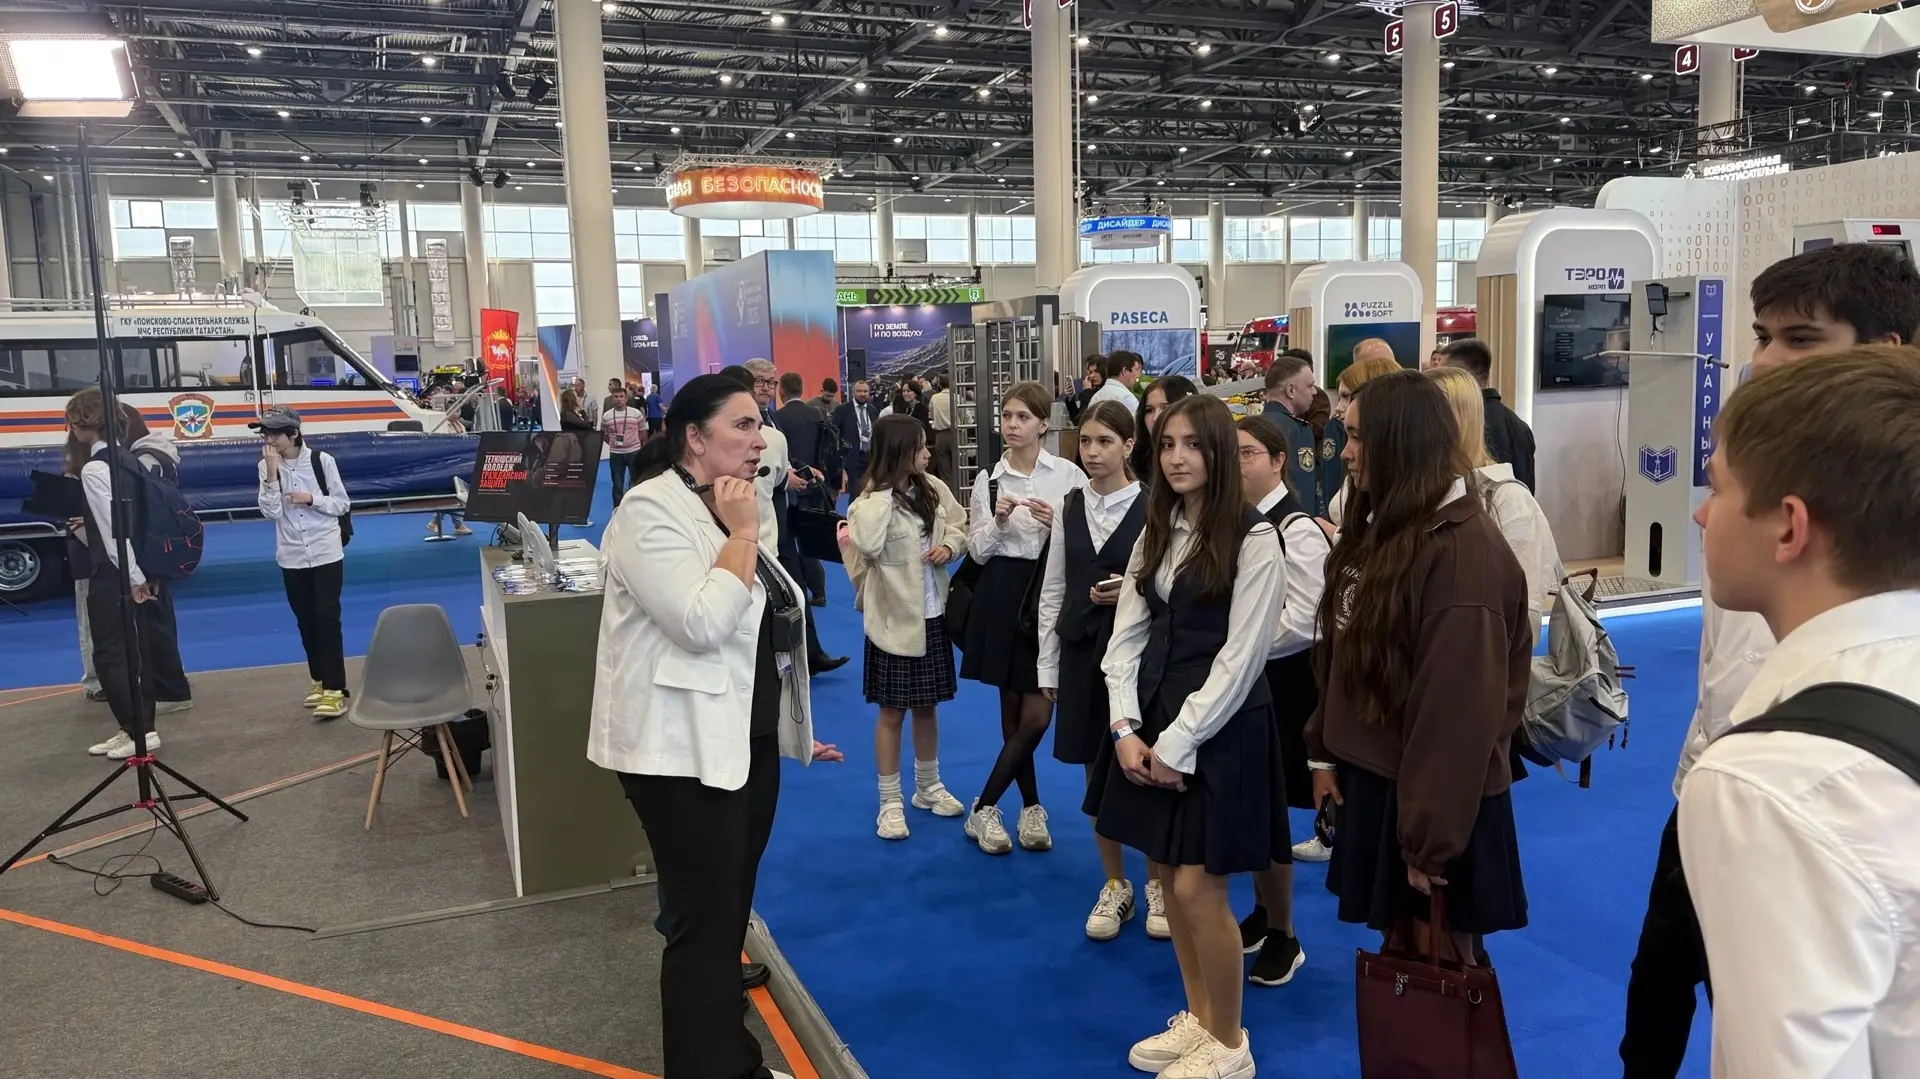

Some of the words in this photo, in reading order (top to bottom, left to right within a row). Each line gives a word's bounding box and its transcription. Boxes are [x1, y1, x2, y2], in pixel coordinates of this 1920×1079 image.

[1441, 9, 1450, 30] 5
[1391, 27, 1400, 46] 5
[1681, 50, 1692, 67] 4
[1097, 218, 1146, 230] ДИСАЙДЕР
[1360, 301, 1393, 309] PUZZLE
[1110, 310, 1169, 325] PASECA
[1371, 310, 1393, 318] SOFT
[120, 317, 132, 326] ГКУ
[224, 316, 250, 325] СЛУЖБА
[885, 322, 909, 330] ЗЕМЛЕ
[137, 327, 152, 335] МЧС
[153, 327, 194, 336] РЕСПУБЛИКИ
[891, 330, 923, 338] ВОЗДУХУ
[485, 453, 523, 464] ТЕТЮШСКИЙ
[482, 463, 515, 472] КОЛЛЕДЖ
[480, 470, 528, 480] ГРАЖДАНСКОЙ
[479, 480, 507, 489] ЗАЩИТЫ
